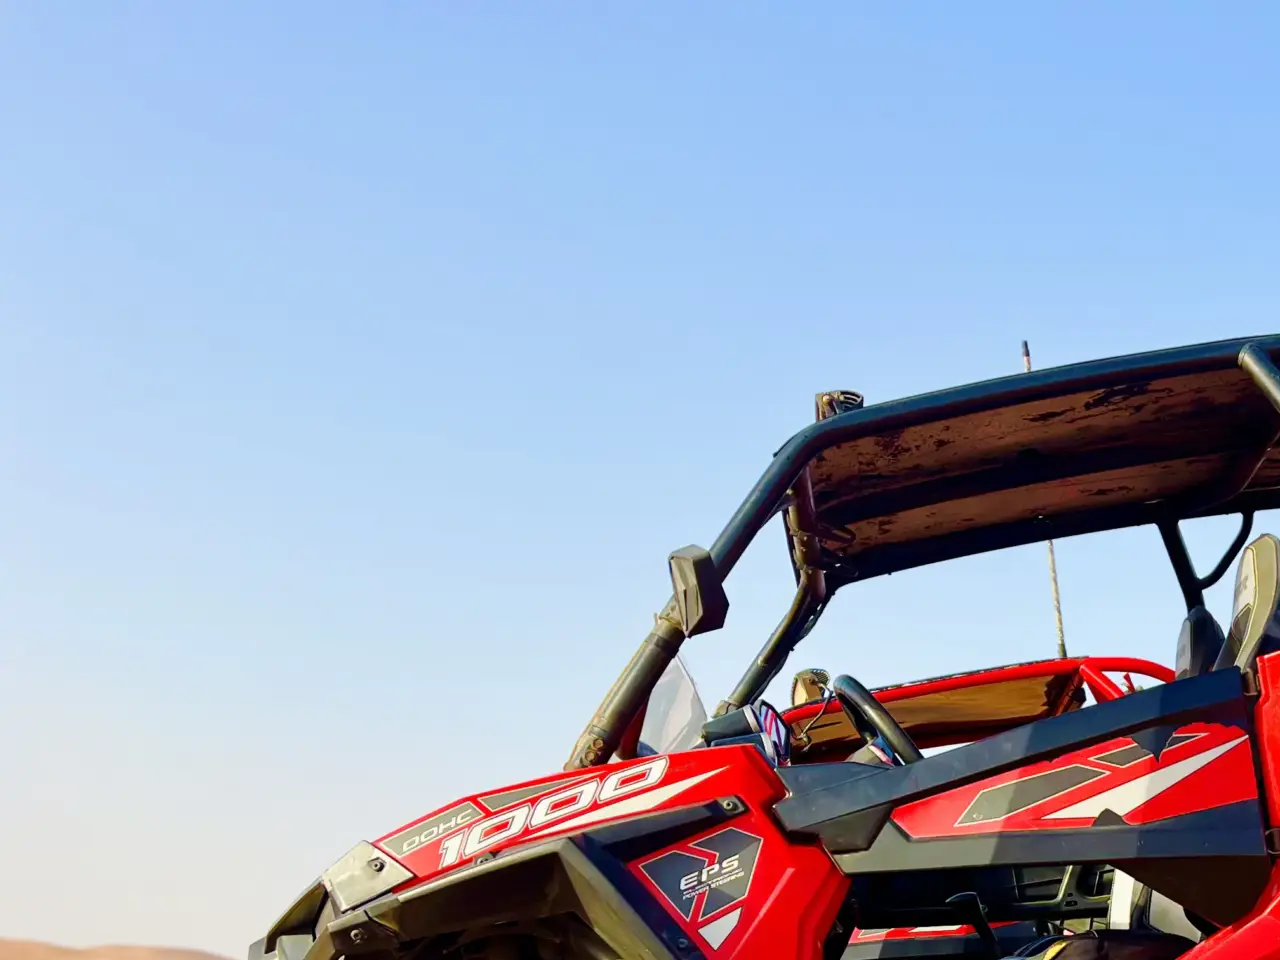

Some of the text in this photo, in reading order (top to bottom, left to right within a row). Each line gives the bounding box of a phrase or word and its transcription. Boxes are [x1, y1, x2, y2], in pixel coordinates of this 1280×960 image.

[402, 808, 473, 851] DOHC
[439, 756, 669, 870] 1000
[680, 854, 740, 891] EPS
